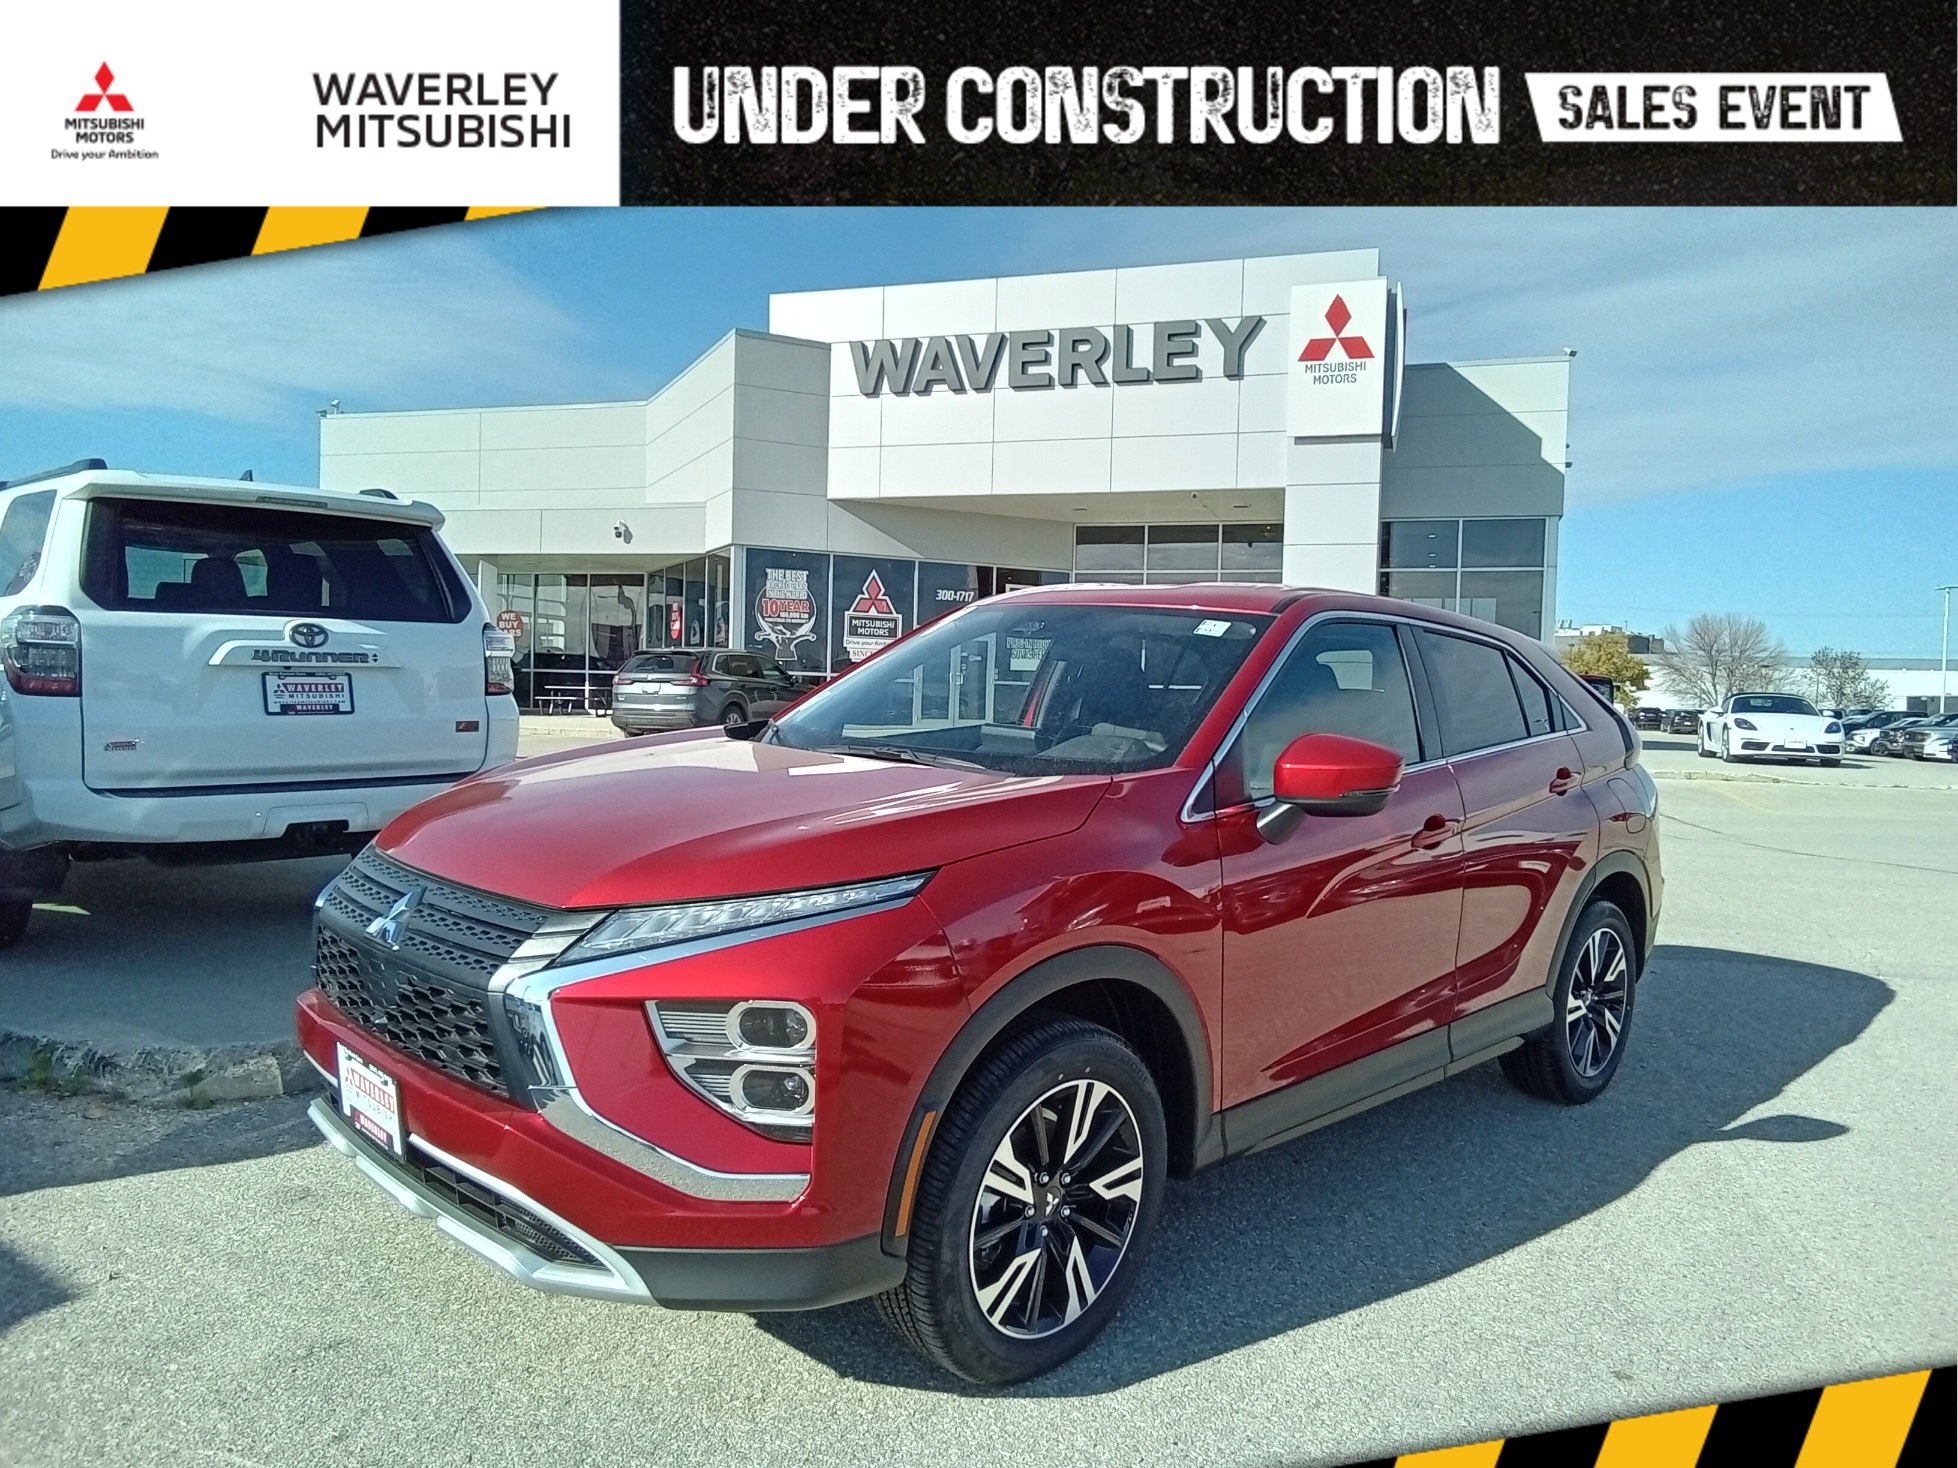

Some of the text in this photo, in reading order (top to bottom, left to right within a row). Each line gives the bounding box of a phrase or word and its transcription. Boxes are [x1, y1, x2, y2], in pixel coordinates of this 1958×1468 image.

[849, 316, 1267, 397] WAVERLEY
[1305, 361, 1366, 374] MITSUBISHI
[1313, 373, 1357, 385] MOTORS
[766, 568, 808, 582] THE BEST
[935, 589, 975, 602] 300-1717
[762, 598, 809, 617] 10 YEAR
[851, 619, 895, 629] MITSUBISHI
[857, 628, 889, 636] MOTORS
[286, 684, 343, 692] WAVERLEY
[352, 1071, 395, 1113] WAVERLEY
